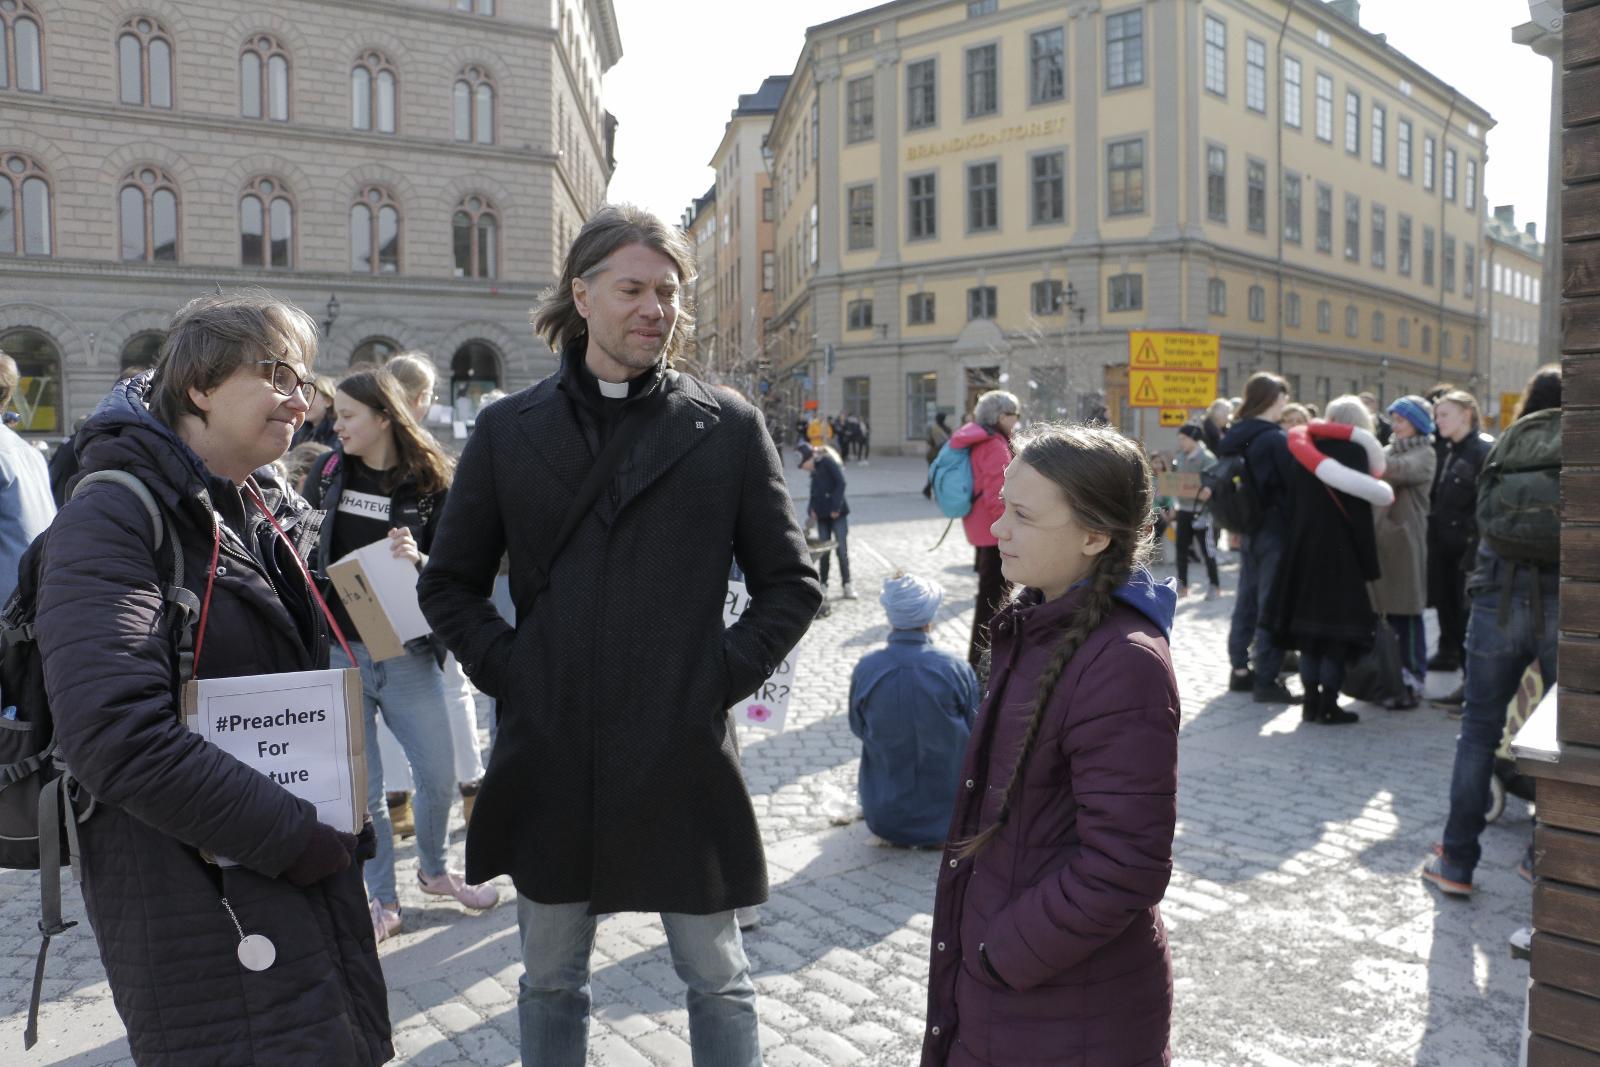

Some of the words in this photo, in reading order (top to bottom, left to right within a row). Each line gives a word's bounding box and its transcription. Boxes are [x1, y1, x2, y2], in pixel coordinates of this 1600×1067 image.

[905, 118, 1066, 161] BRANDKONTORET
[1163, 374, 1196, 385] Warning
[1198, 375, 1209, 383] for
[1163, 386, 1190, 394] vehicle
[1193, 386, 1207, 394] and
[340, 495, 391, 514] WHATEVE
[215, 708, 326, 733] #Preachers
[257, 740, 290, 758] For
[268, 768, 309, 785] ture
